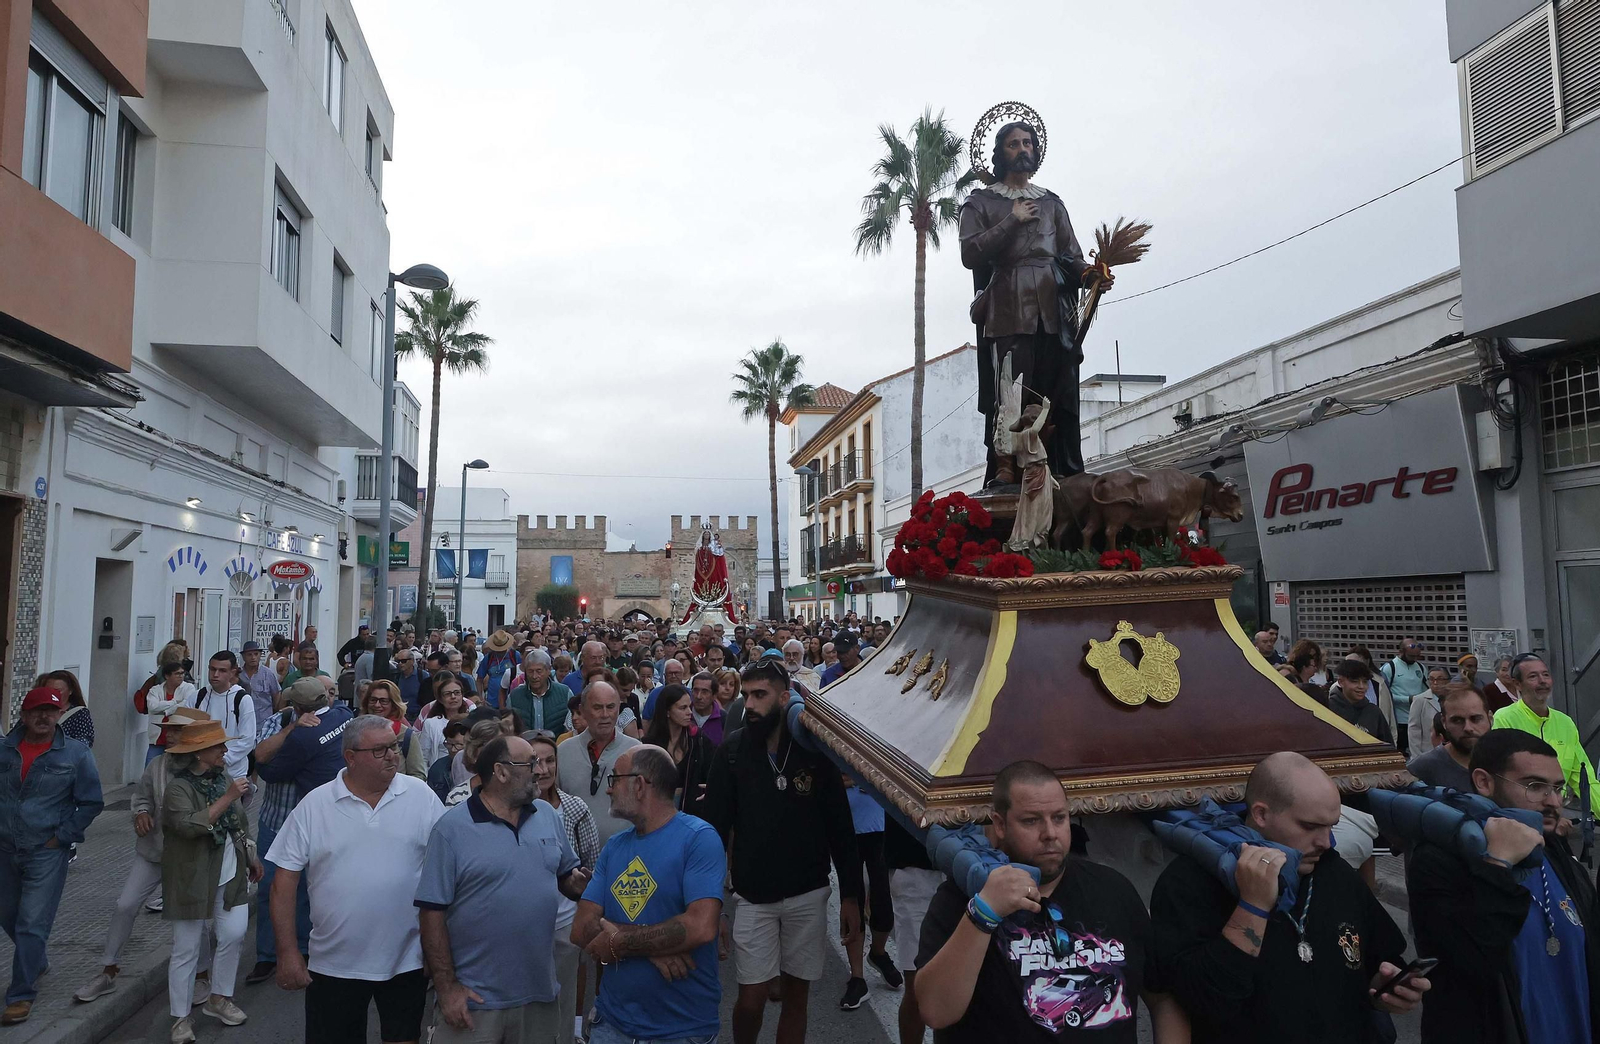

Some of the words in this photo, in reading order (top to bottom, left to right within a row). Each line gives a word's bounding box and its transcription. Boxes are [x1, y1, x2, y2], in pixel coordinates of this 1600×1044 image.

[1264, 463, 1458, 519] Peinarte
[1299, 518, 1343, 531] Campos
[257, 624, 289, 632] ZUMOS
[614, 878, 650, 890] MAXI
